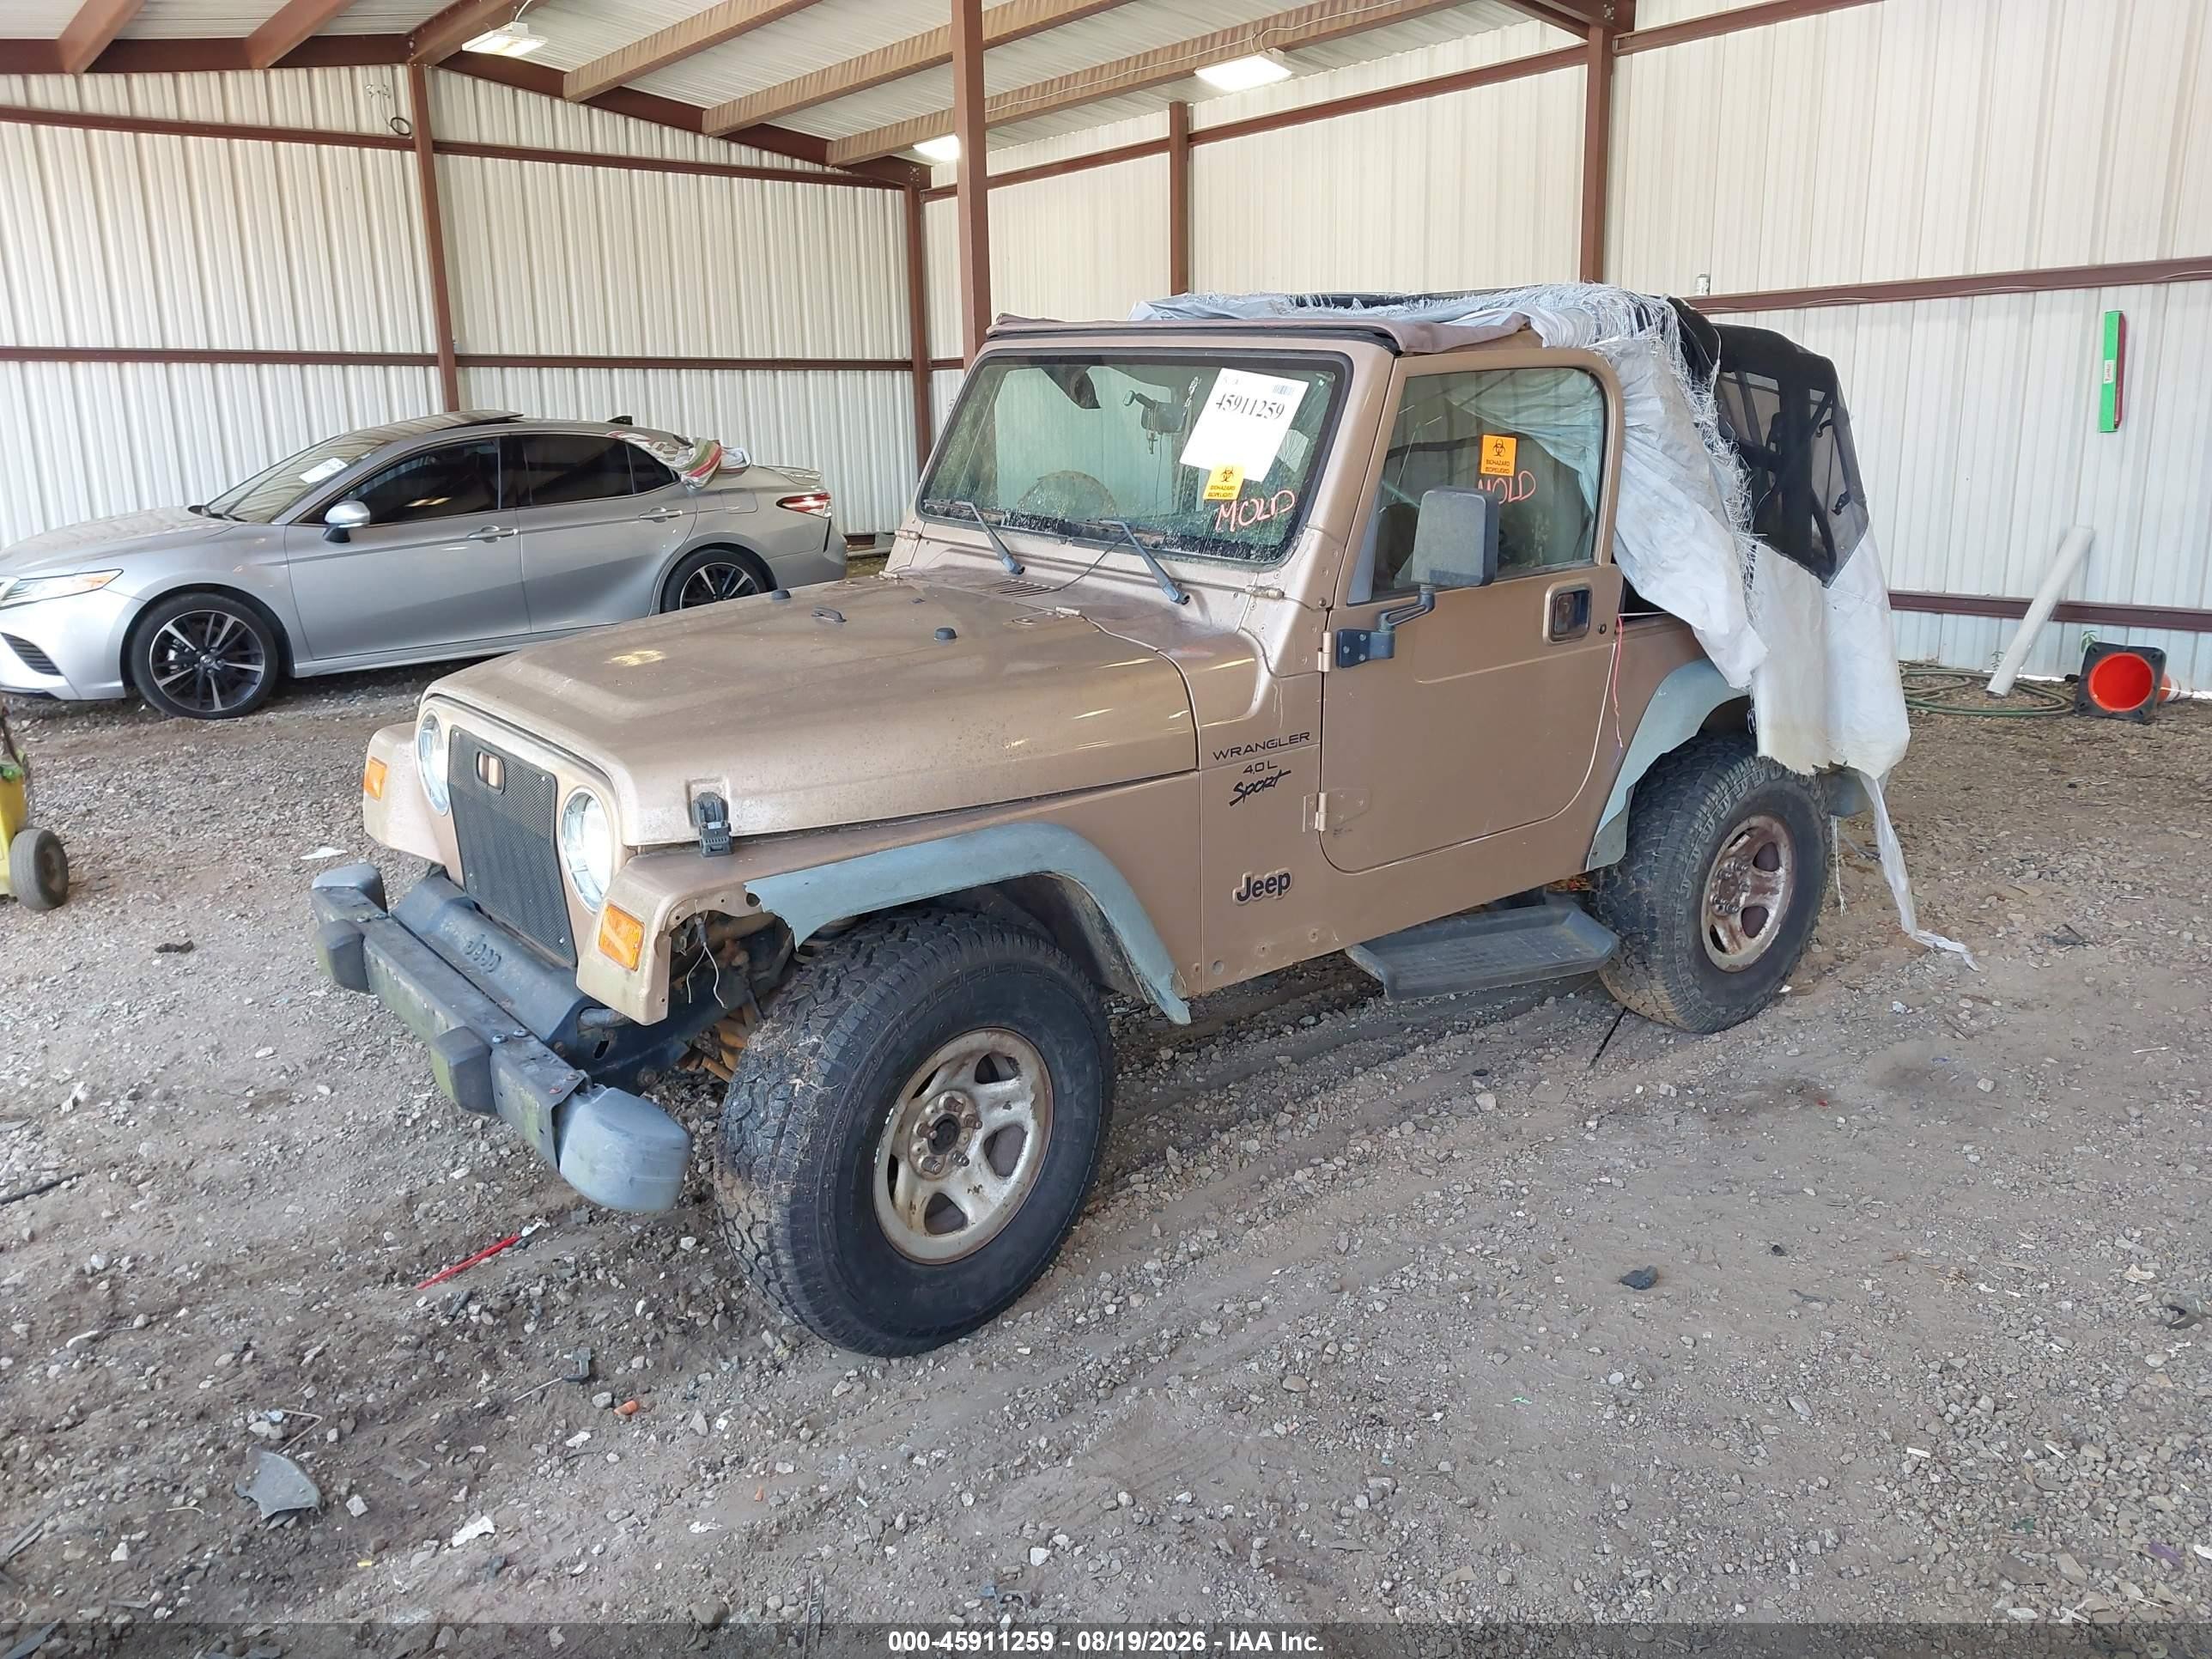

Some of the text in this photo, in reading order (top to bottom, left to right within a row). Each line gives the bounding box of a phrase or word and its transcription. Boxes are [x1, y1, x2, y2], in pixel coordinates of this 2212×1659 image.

[1216, 393, 1285, 420] 45911259
[1215, 489, 1296, 532] MOLD
[1212, 732, 1310, 762] WRANGLER
[1229, 769, 1291, 806] Sport
[1236, 871, 1291, 902] Jeep
[465, 933, 502, 973] Jeep
